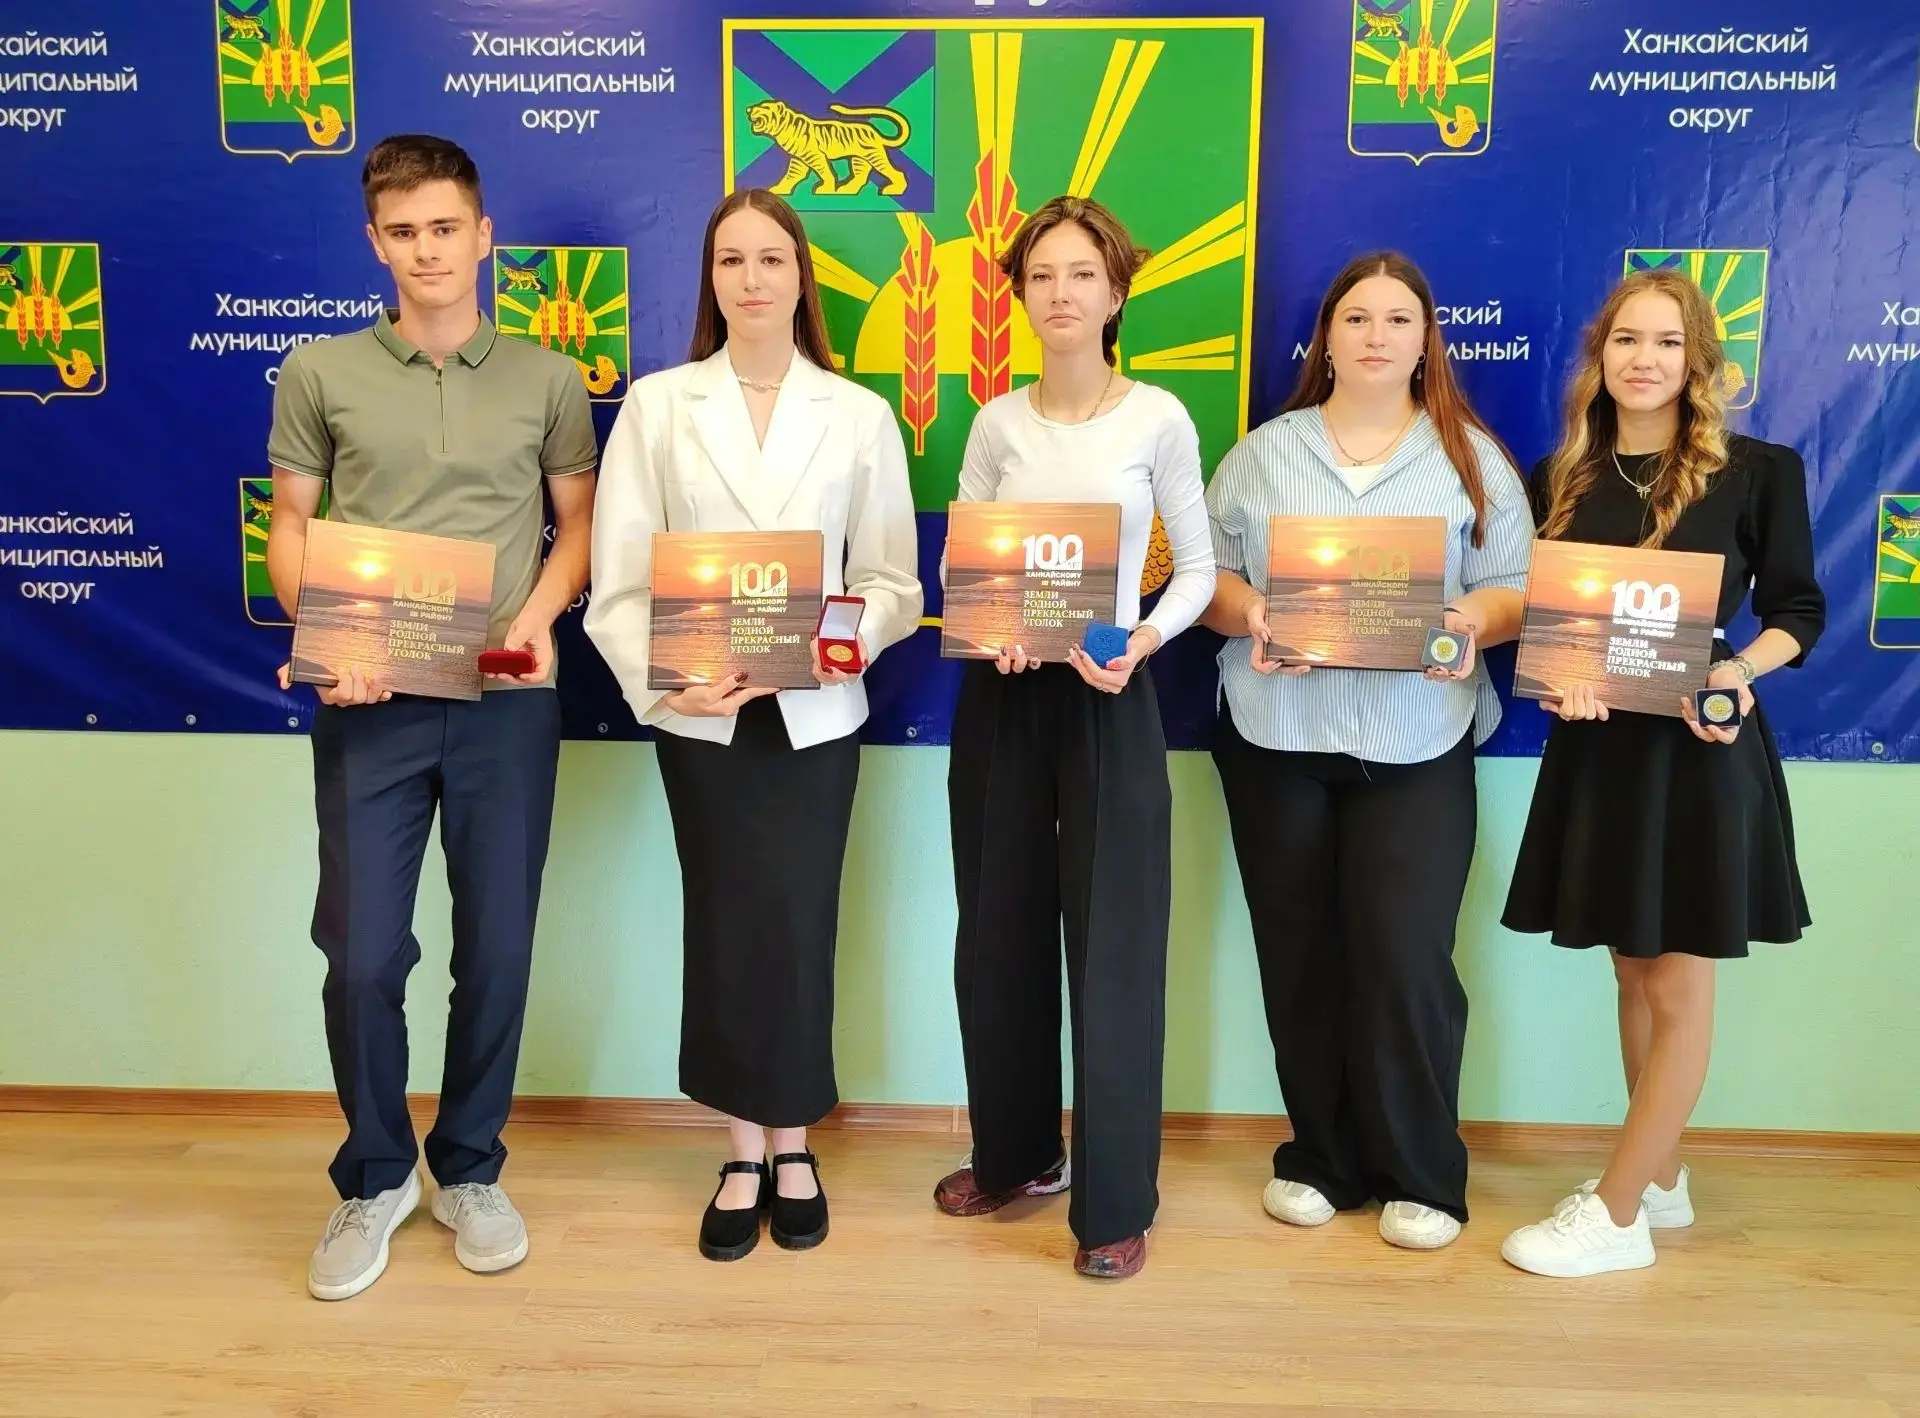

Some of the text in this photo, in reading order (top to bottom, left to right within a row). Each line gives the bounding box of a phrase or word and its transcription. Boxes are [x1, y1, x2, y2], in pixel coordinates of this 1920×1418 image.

[472, 30, 646, 57] Ханкайский
[1622, 27, 1809, 54] Ханкайский
[444, 67, 675, 98] муниципальный
[1589, 64, 1837, 97] муниципальный
[521, 109, 600, 134] округ
[1668, 107, 1753, 133] округ
[215, 293, 384, 318] Ханкайский
[0, 545, 164, 568] иципальный
[1023, 534, 1083, 571] 100
[1347, 545, 1410, 580] 100
[728, 561, 788, 598] 100
[1025, 571, 1081, 579] ХАНКАЙСКОМУ
[21, 581, 96, 604] округ
[392, 567, 457, 606] 100
[1024, 591, 1059, 599] ЗЕМЛИ
[1611, 580, 1681, 623] 100
[392, 600, 455, 613] ХАНКАЙСКОМУ
[1023, 599, 1067, 609] РОДНОЙ
[1348, 600, 1386, 609] ЗЕМЛИ
[420, 611, 454, 622] РАЙОНУ
[1023, 609, 1094, 619] ПРЕКРАСНЫЙ
[1348, 608, 1395, 618] РОДНОЙ
[389, 620, 429, 632] ЗЕМЛИ
[731, 618, 766, 626] ЗЕМЛИ
[1023, 619, 1064, 628] УГОЛОК
[1348, 618, 1423, 628] ПРЕКРАСНЫЙ
[388, 629, 438, 642] РОДНОЙ
[730, 626, 774, 635] РОДНОЙ
[1348, 627, 1391, 635] УГОЛОК
[730, 635, 801, 645] ПРЕКРАСНЫЙ
[1608, 637, 1649, 649] ЗЕМЛИ
[387, 639, 466, 655] ПРЕКРАСНЫЙ
[730, 645, 771, 654] УГОЛОК
[1607, 646, 1659, 660] РОДНОЙ
[386, 648, 432, 661] УГОЛОК
[1606, 656, 1688, 673] ПРЕКРАСНЫЙ
[1605, 665, 1652, 678] УГОЛОК
